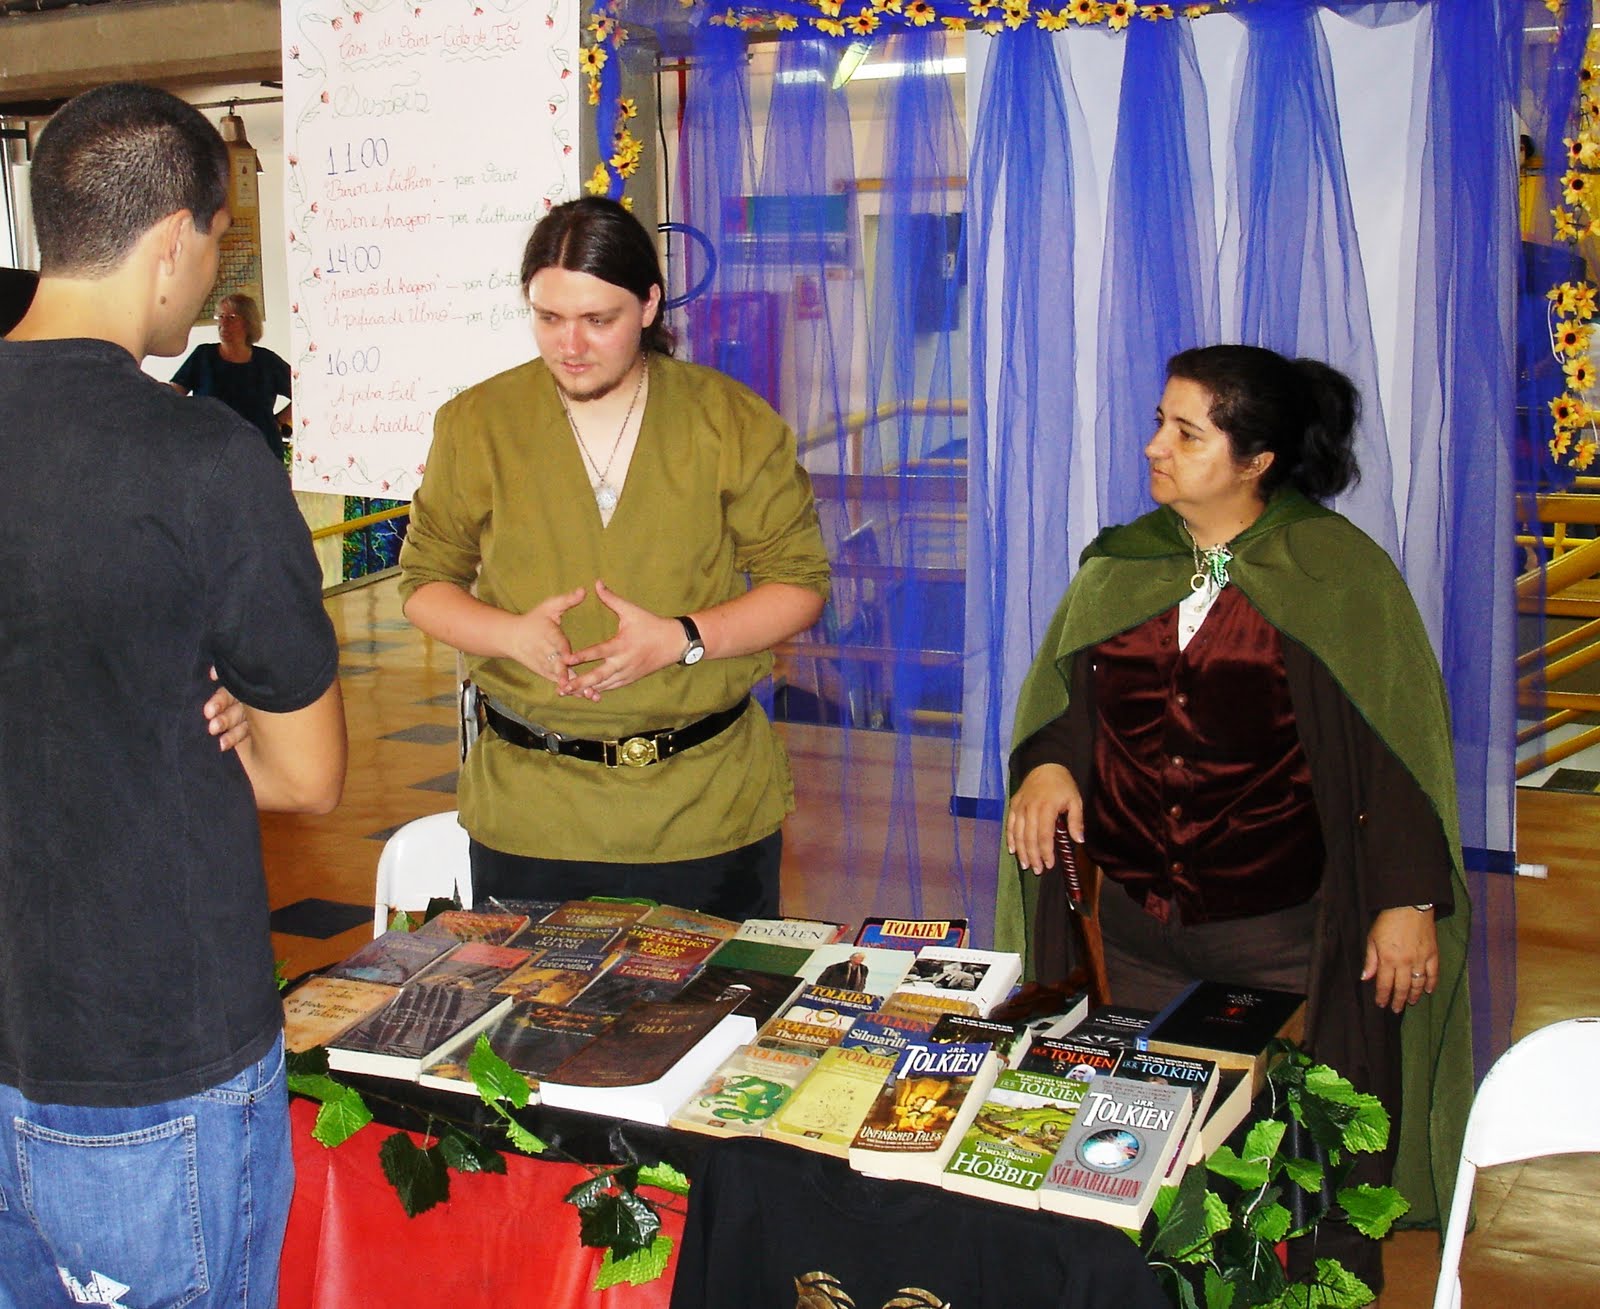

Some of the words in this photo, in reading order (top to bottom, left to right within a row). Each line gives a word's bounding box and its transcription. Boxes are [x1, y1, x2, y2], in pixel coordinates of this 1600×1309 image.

[744, 925, 823, 940] TOLKIEN
[886, 921, 946, 938] TOLKIEN
[811, 985, 875, 1005] TOLKIEN
[628, 1022, 697, 1034] TOLKIEN
[775, 1020, 841, 1039] TOLKIEN
[866, 1013, 932, 1033] TOLKIEN
[882, 1026, 902, 1039] The
[775, 1029, 796, 1039] The
[796, 1032, 830, 1045] Hobbit
[848, 1028, 911, 1048] Silmarill
[744, 1046, 812, 1067] TOLKIEN
[837, 1049, 895, 1070] TOLKIE
[896, 1044, 985, 1081] TOLKIEN
[1050, 1049, 1116, 1069] TOLKIEN
[1141, 1062, 1209, 1083] TOLKIEN
[1019, 1081, 1085, 1102] TOLKIEN
[1082, 1092, 1175, 1131] TOLKIEN
[860, 1126, 914, 1142] UNFINISHED
[913, 1130, 942, 1143] TALES
[976, 1145, 1000, 1156] LORD
[1006, 1151, 1034, 1164] RINGS
[993, 1157, 1012, 1167] THE
[951, 1152, 1043, 1188] HOBBIT
[1048, 1163, 1143, 1199] SILMARILLION
